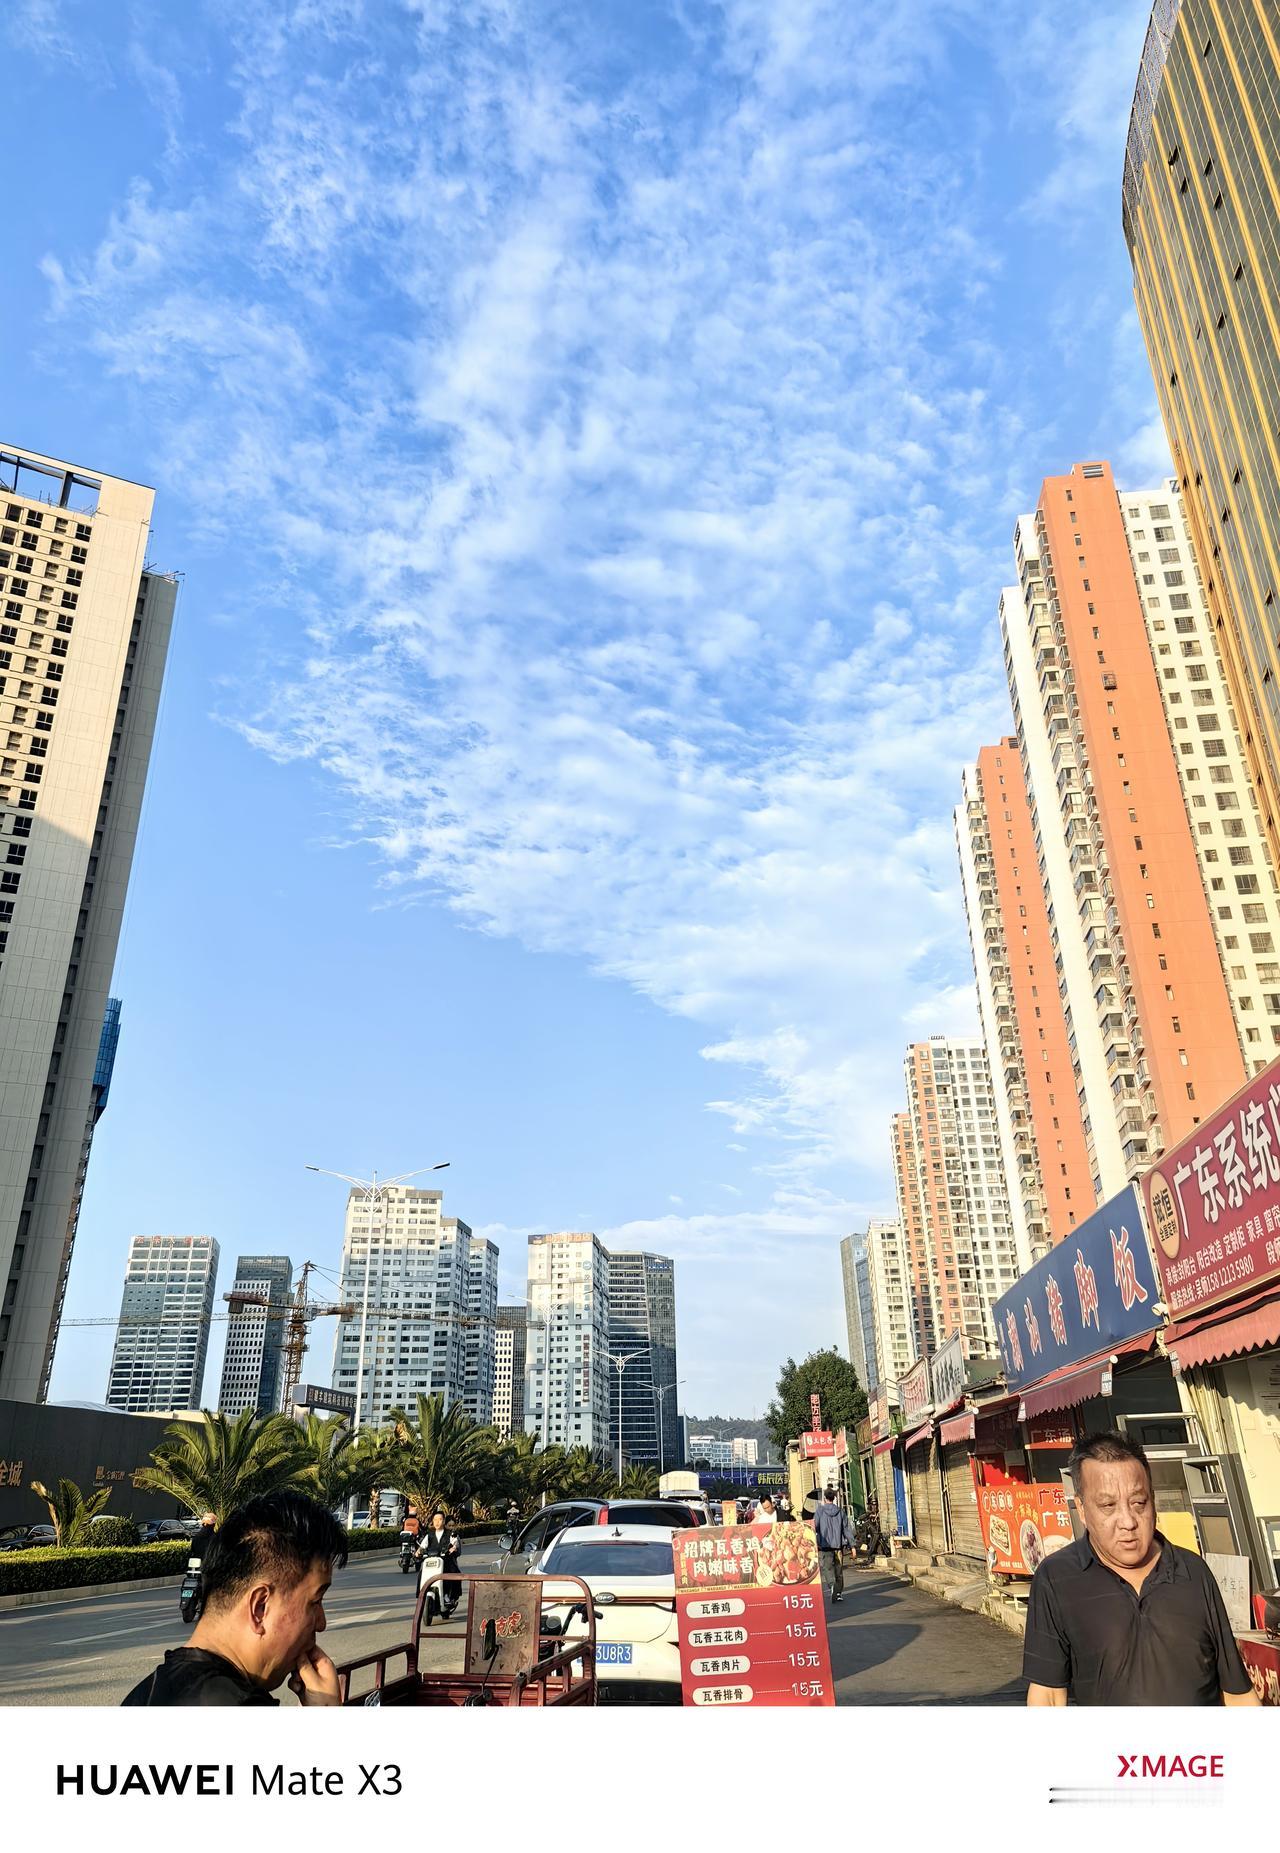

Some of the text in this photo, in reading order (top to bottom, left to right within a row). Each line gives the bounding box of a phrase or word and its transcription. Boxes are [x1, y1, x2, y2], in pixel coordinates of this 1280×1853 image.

[1245, 1215, 1265, 1243] 家具
[1038, 1488, 1066, 1506] 广东
[1041, 1510, 1070, 1528] 广东
[693, 1556, 754, 1578] 肉嫩味香
[701, 1593, 814, 1615] 瓦香鸡 15元
[693, 1622, 817, 1644] 瓦香五花肉 15元
[596, 1645, 631, 1661] 3U8R3
[700, 1651, 820, 1673] 瓦香肉片 15元
[702, 1688, 744, 1702] 瓦香排骨
